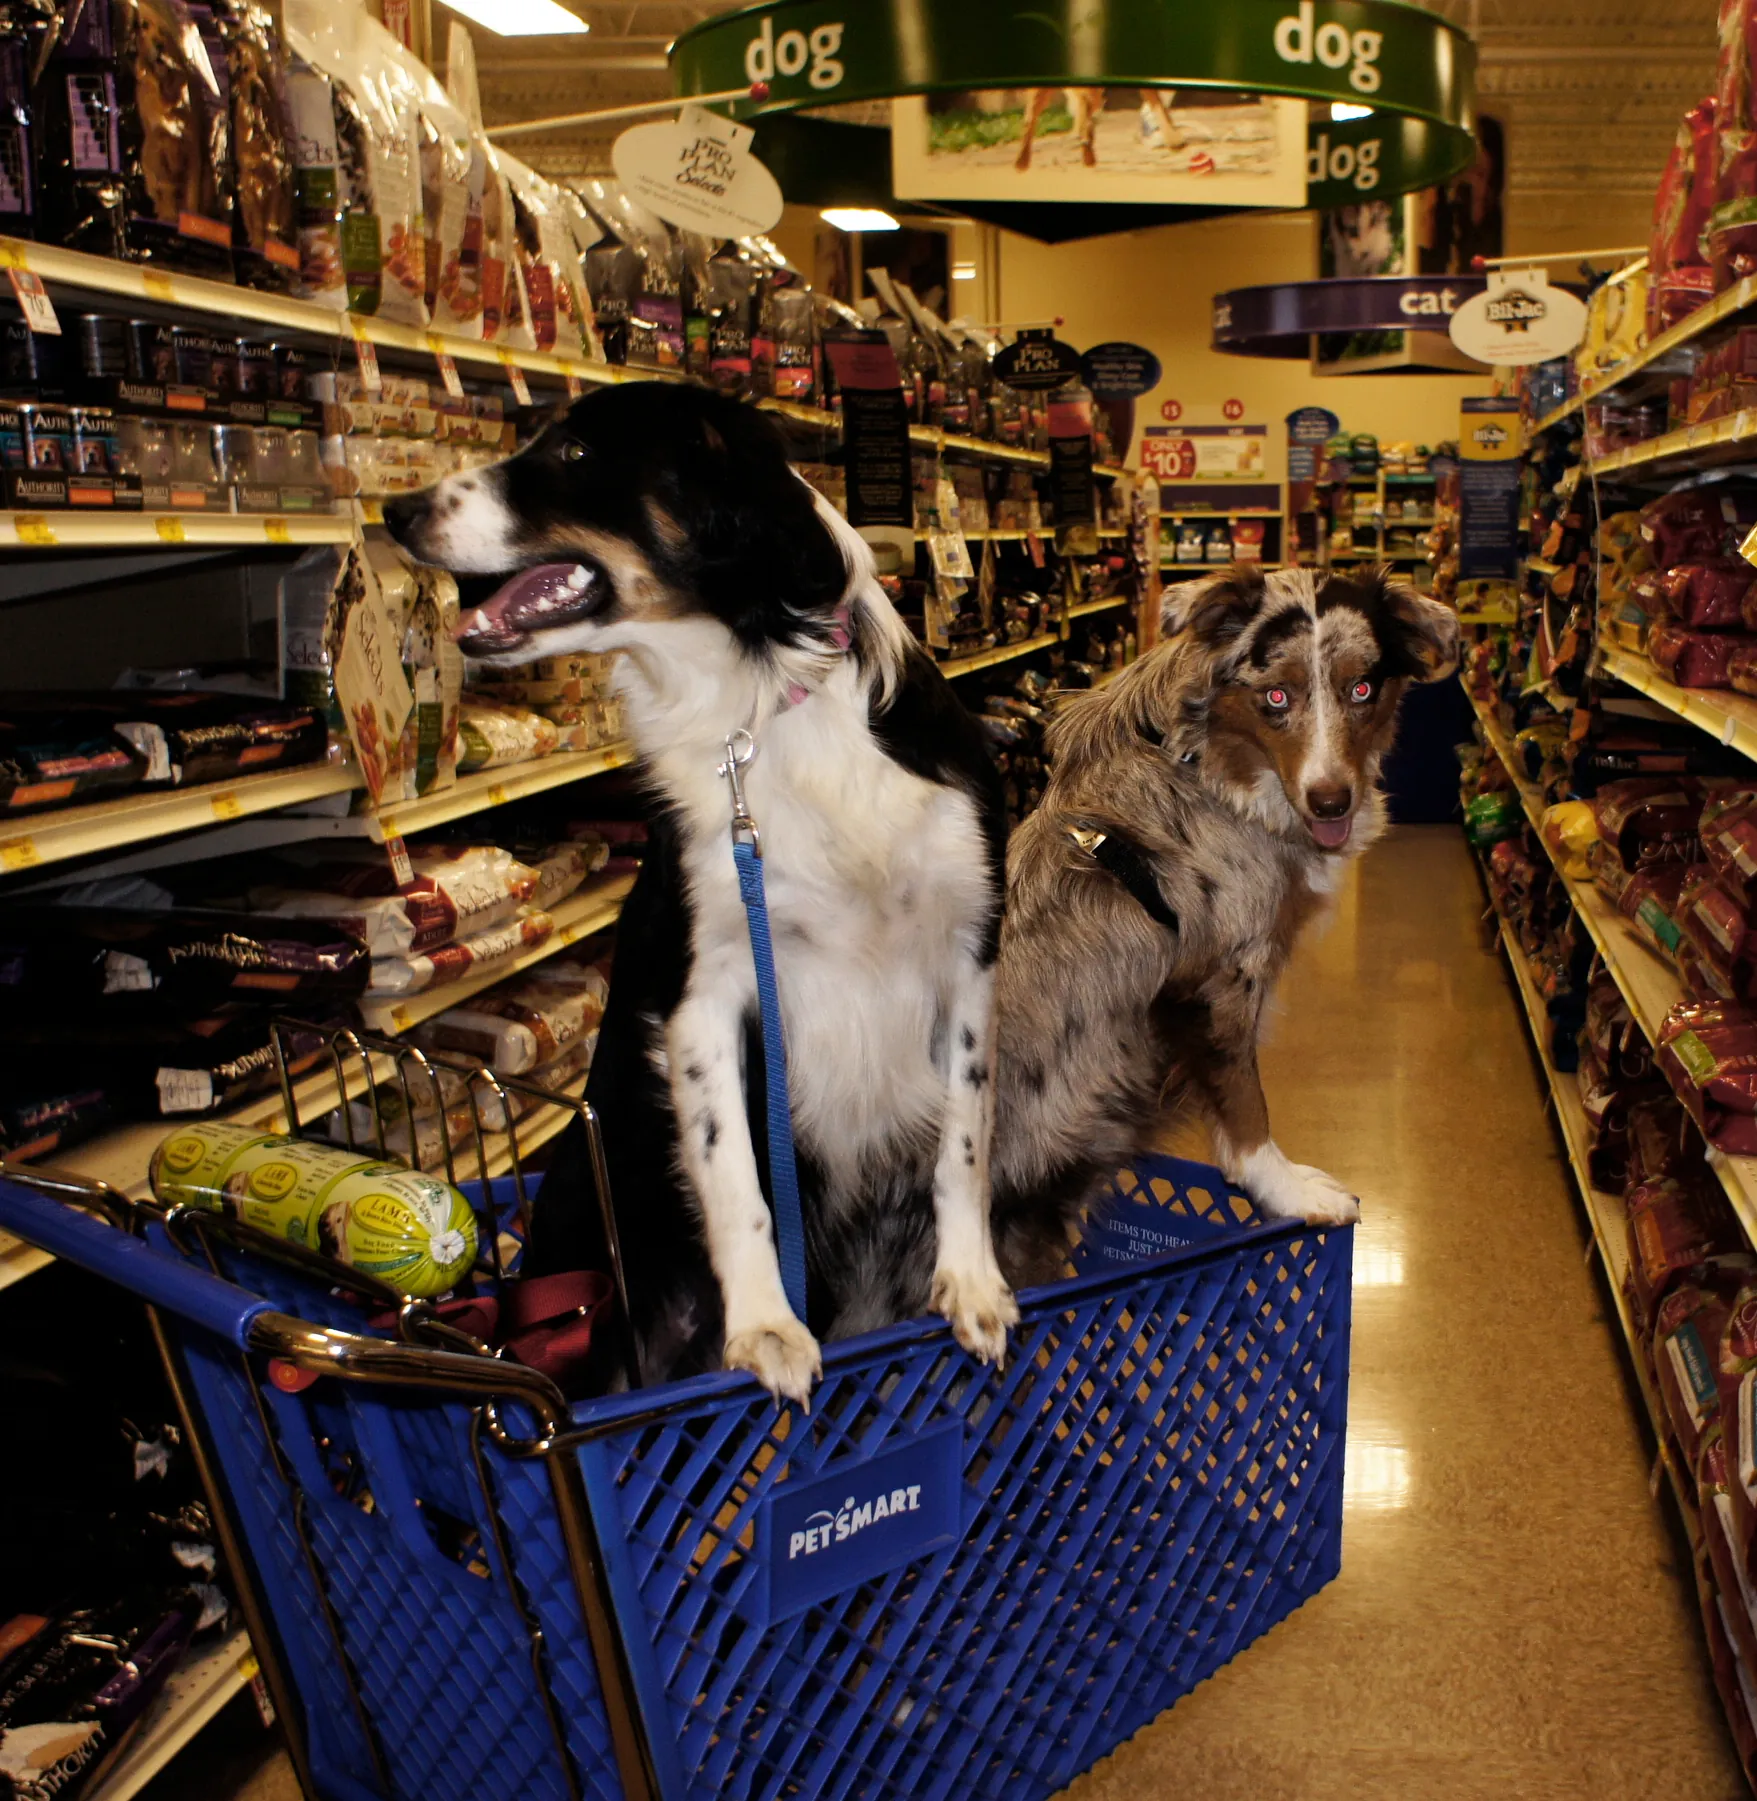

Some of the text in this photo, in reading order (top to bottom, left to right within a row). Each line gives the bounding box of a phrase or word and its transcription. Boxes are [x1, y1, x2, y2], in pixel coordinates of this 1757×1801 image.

[745, 16, 845, 90] dog
[1273, 0, 1384, 93] dog
[679, 148, 737, 182] PLAN
[693, 137, 733, 165] PRO
[1307, 134, 1381, 191] dog
[1399, 285, 1458, 316] cat
[1012, 358, 1061, 373] PLAN
[1020, 346, 1055, 361] PRO
[1108, 1218, 1140, 1238] ITEMS
[1140, 1227, 1163, 1244] TOO
[1128, 1239, 1153, 1256] JUST
[789, 1484, 921, 1560] PETSMART
